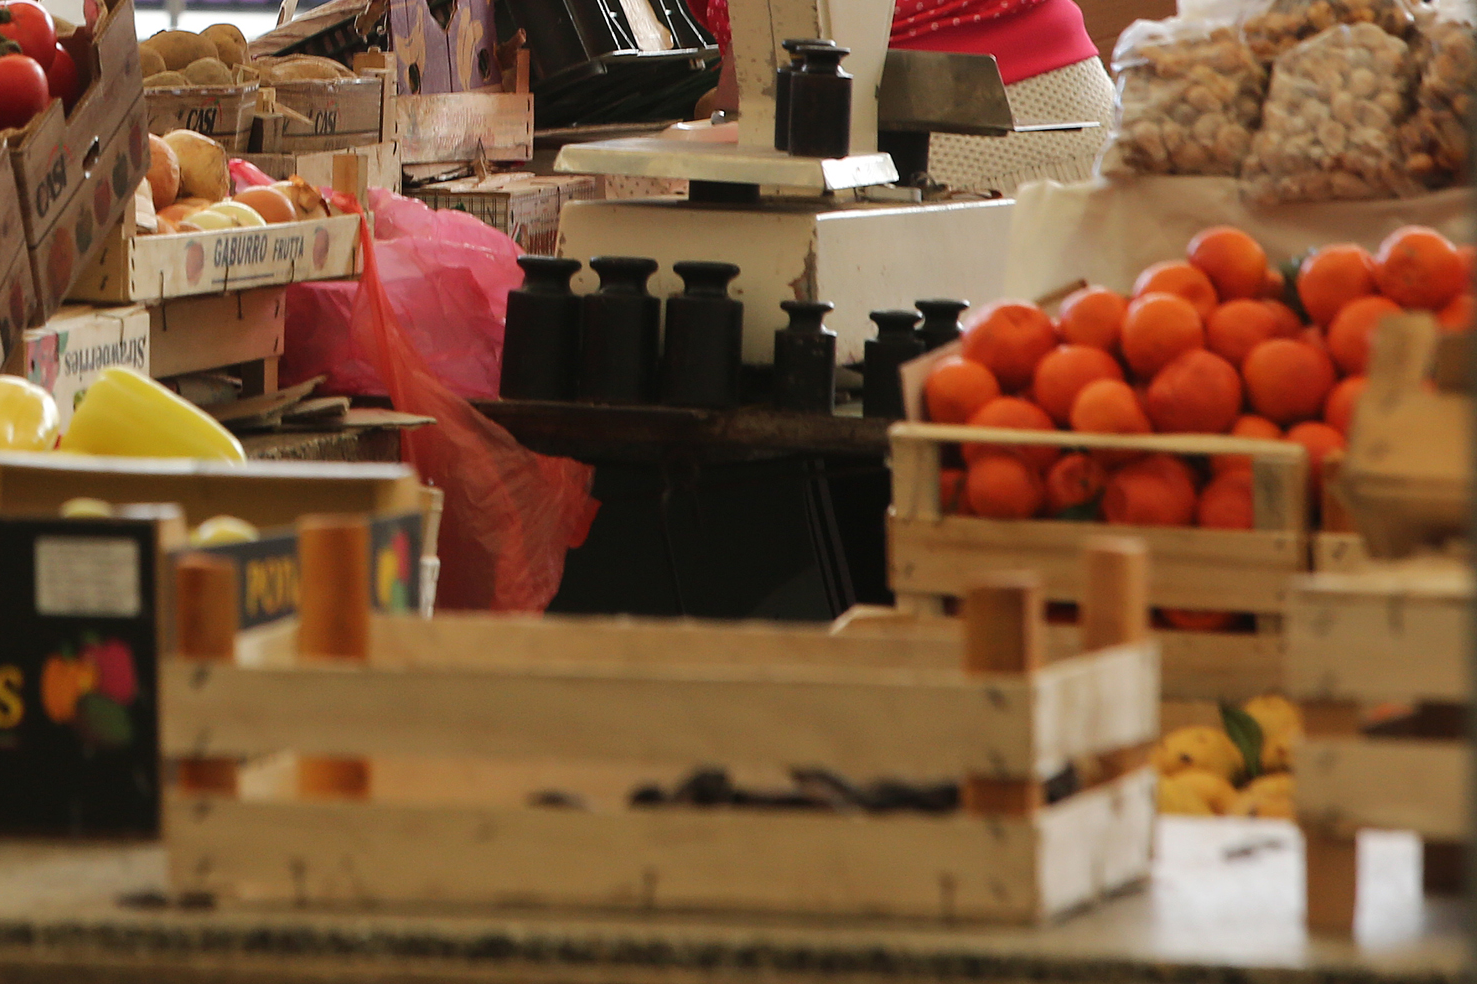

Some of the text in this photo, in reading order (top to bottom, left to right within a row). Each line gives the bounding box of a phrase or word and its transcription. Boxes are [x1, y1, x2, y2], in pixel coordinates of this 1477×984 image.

[185, 107, 218, 134] CASI
[314, 108, 337, 136] CASI
[35, 153, 68, 219] CASI
[213, 233, 304, 267] GABURRO FRUTTA
